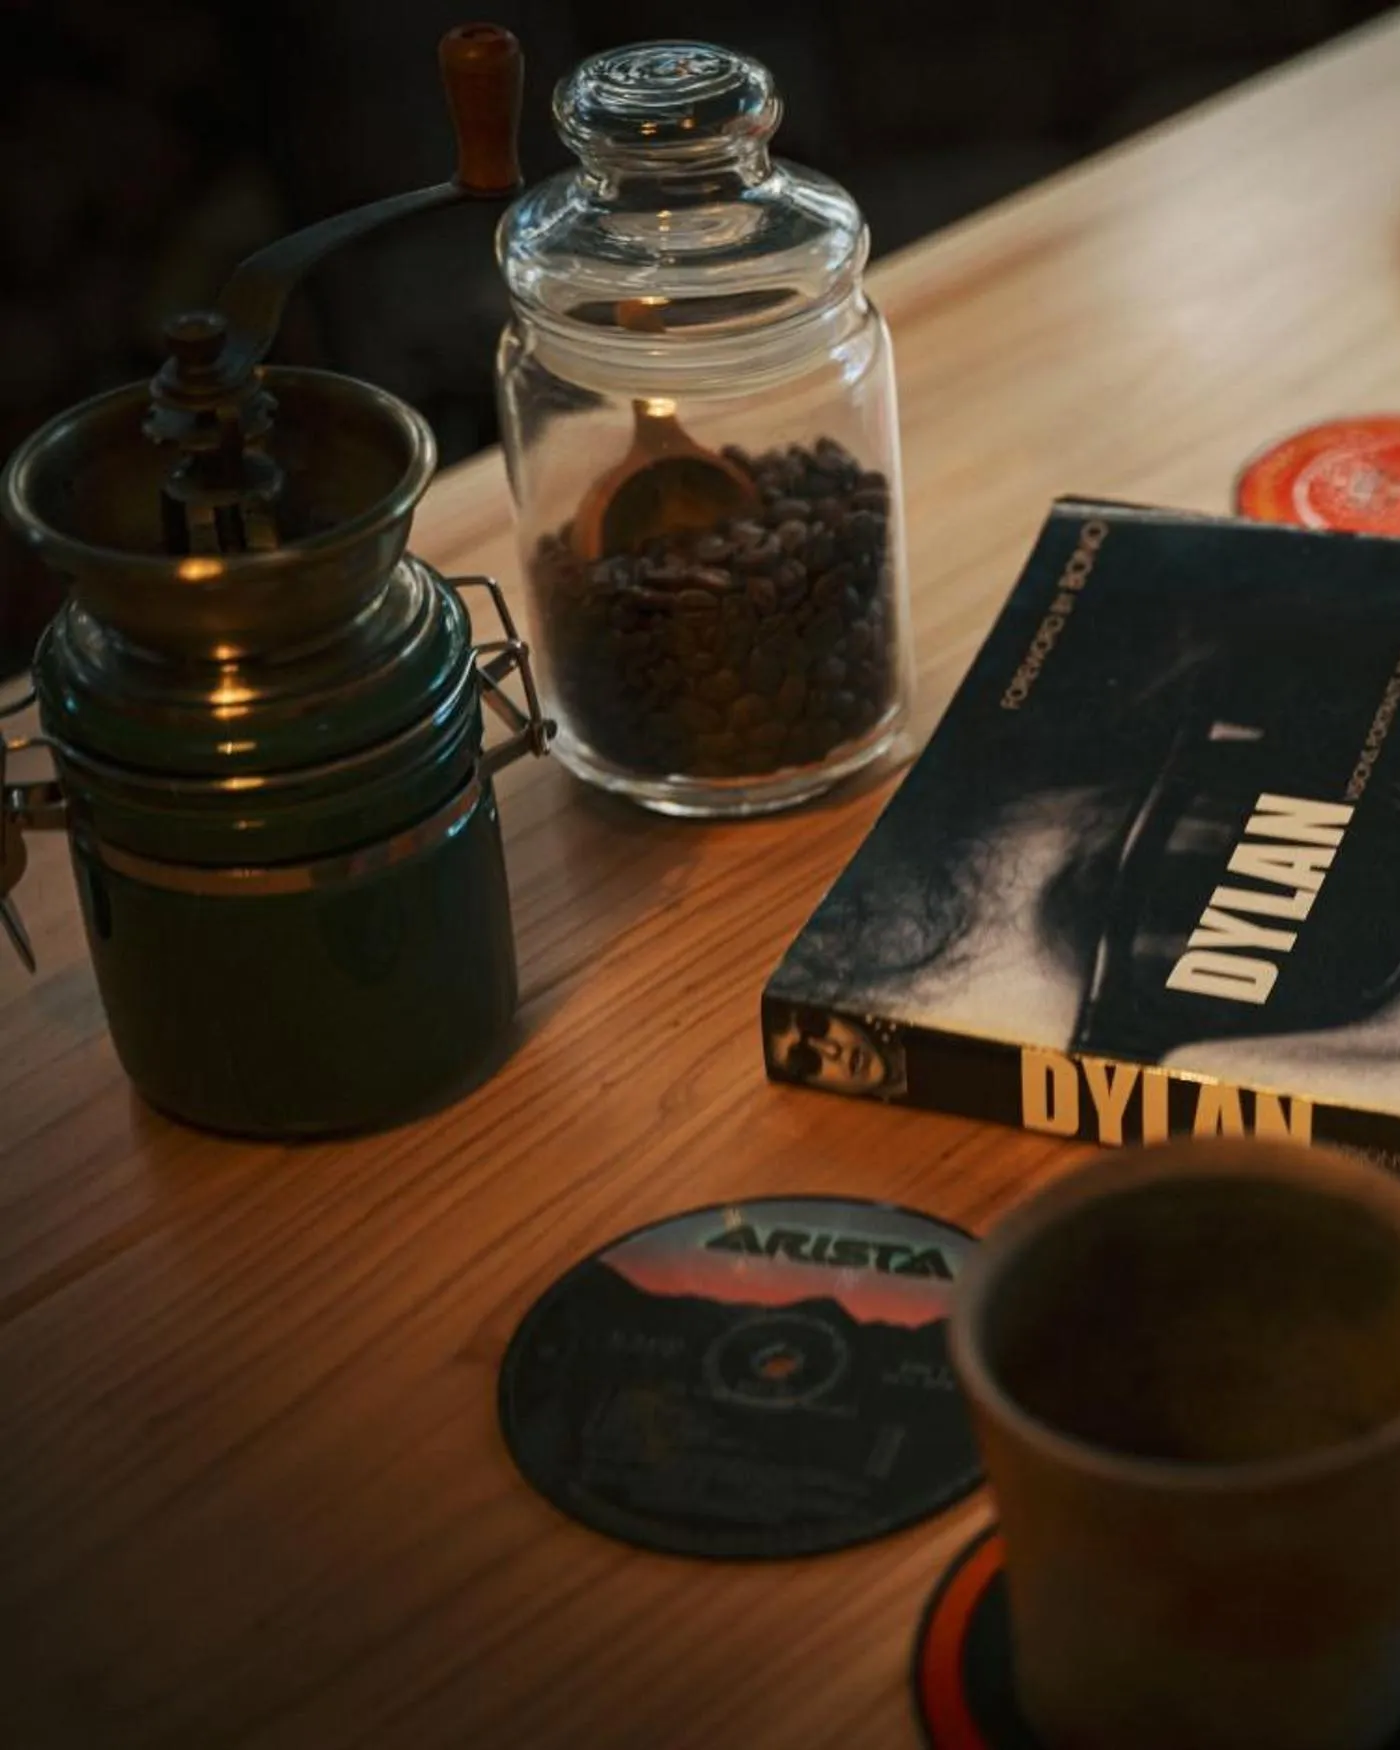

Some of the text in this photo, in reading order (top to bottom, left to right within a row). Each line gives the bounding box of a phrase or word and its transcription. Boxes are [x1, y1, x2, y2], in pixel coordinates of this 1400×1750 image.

[1059, 519, 1109, 590] BONO
[1165, 793, 1355, 1004] DYLAN
[704, 1225, 955, 1281] ARISTA
